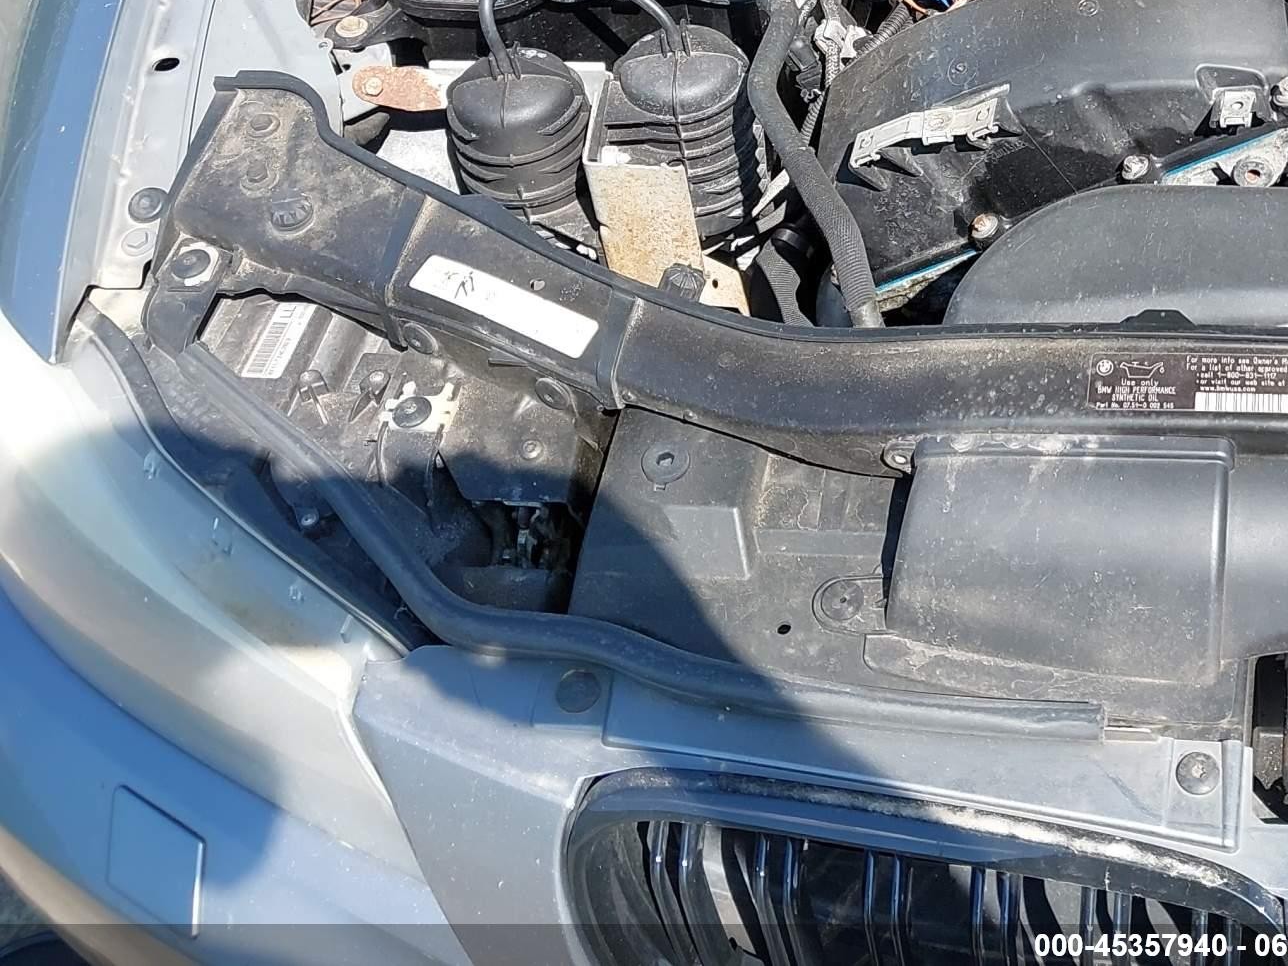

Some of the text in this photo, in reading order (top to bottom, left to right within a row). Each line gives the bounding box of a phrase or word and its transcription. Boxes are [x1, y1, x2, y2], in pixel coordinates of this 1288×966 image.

[1186, 355, 1198, 363] For
[1201, 356, 1218, 364] more
[1221, 356, 1235, 364] info
[1253, 356, 1279, 365] Owner's
[1186, 363, 1198, 371] For
[1209, 363, 1221, 372] list
[1225, 364, 1233, 372] of
[1236, 364, 1254, 372] other
[1257, 365, 1288, 374] approved
[1200, 371, 1214, 379] call
[1121, 378, 1159, 387] Use only
[1211, 378, 1227, 386] visit
[1261, 379, 1275, 387] site
[1278, 379, 1286, 387] at
[1097, 386, 1176, 395] BMW HIGH PERFORMANCE
[1112, 394, 1159, 402] SYNTHETIC OIL
